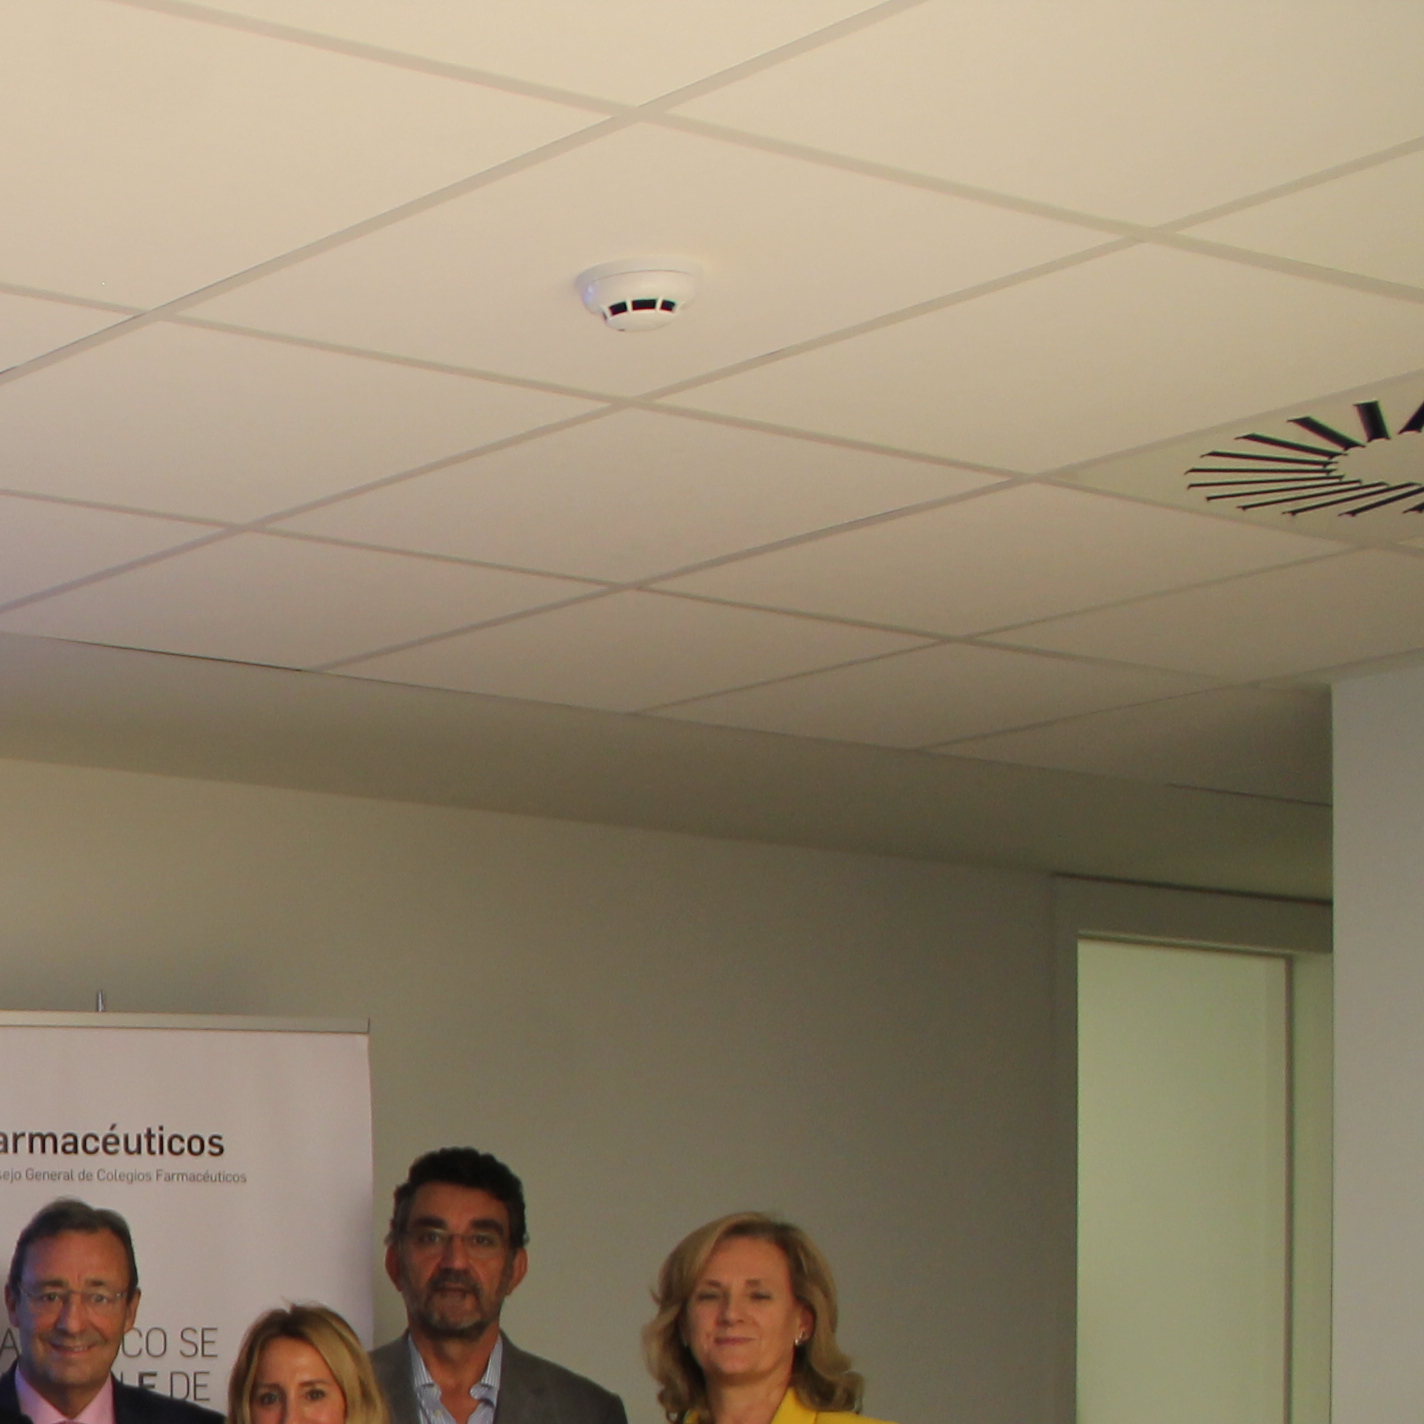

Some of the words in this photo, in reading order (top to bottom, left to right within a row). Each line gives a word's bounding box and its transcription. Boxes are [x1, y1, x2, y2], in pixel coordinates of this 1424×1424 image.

[25, 1167, 74, 1182] General
[77, 1168, 93, 1182] de
[97, 1168, 152, 1185] Colegios
[155, 1168, 248, 1184] Farmacéuticos
[179, 1327, 218, 1358] SE
[170, 1371, 211, 1402] DE
